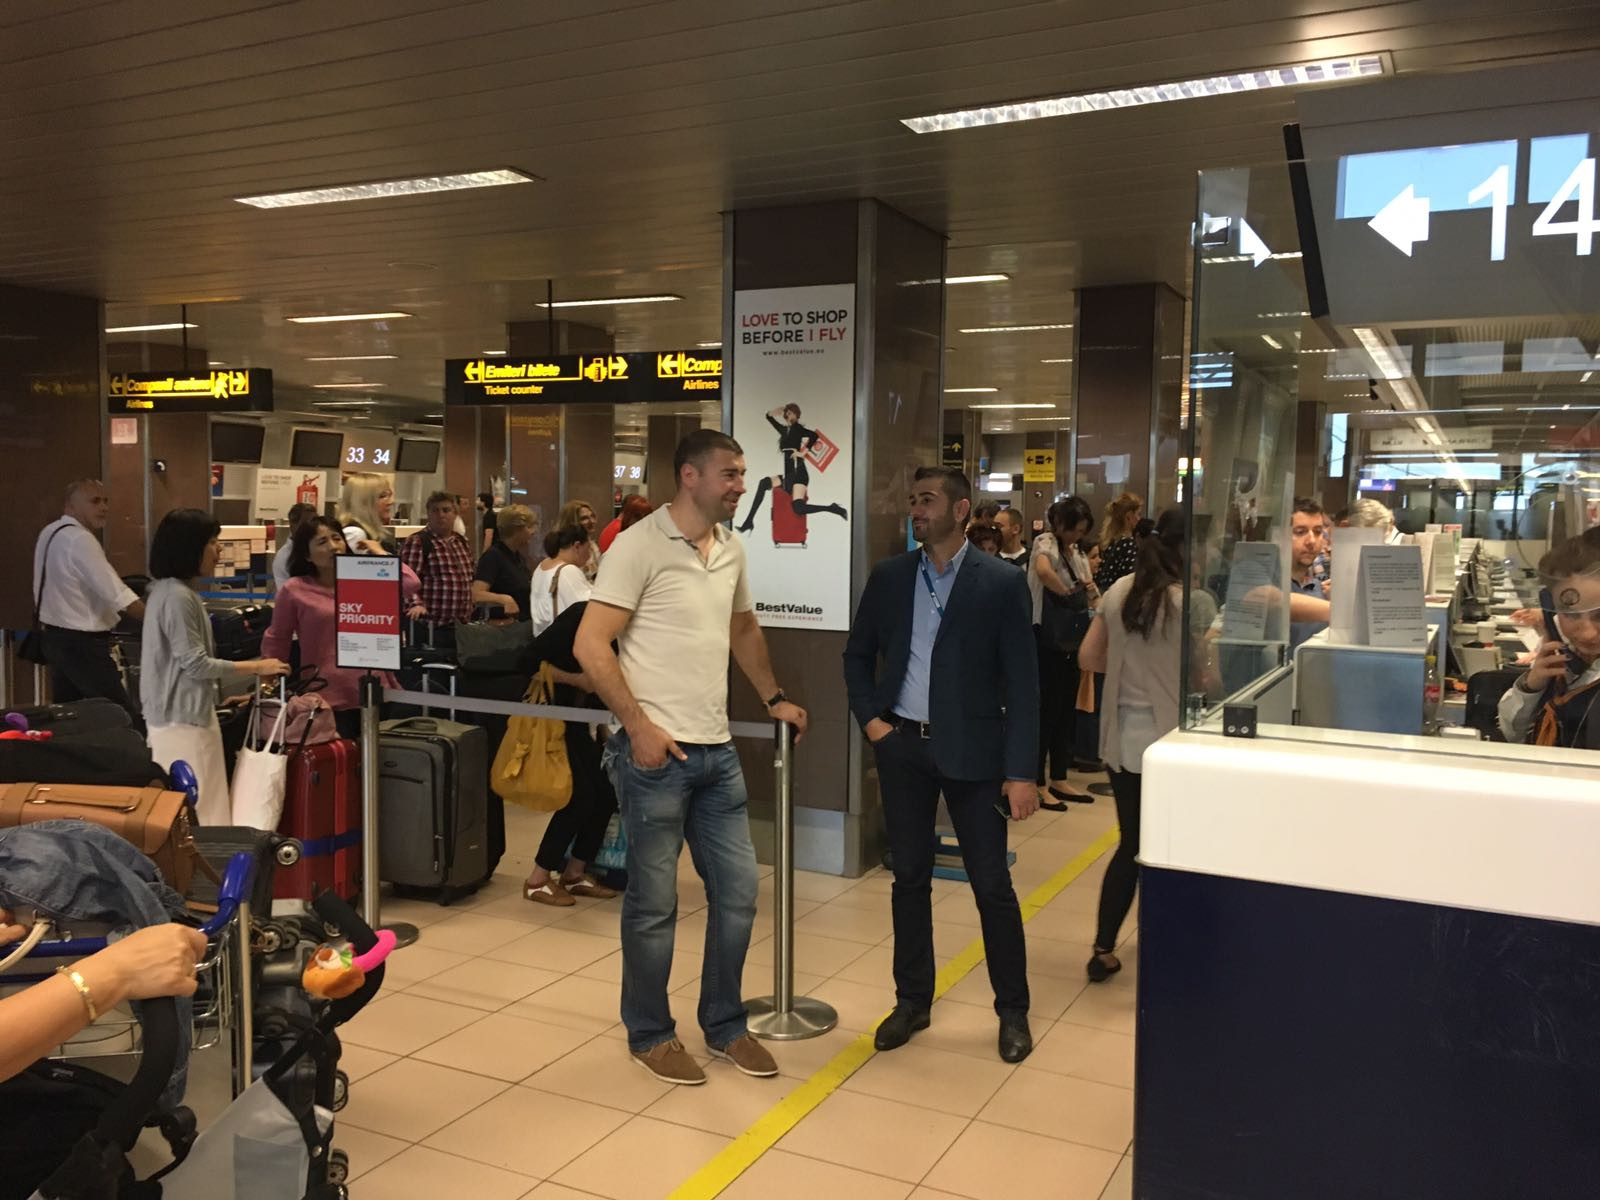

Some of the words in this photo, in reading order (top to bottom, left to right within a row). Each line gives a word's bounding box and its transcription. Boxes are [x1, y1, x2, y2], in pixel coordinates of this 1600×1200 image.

[1468, 157, 1600, 262] 14
[742, 313, 779, 327] LOVE
[782, 311, 803, 326] TO
[806, 309, 848, 325] SHOP
[742, 329, 804, 345] BEFORE
[809, 329, 814, 342] I
[819, 327, 847, 342] FLY
[685, 357, 722, 374] Comp
[484, 385, 510, 395] Ticket
[511, 385, 544, 395] counter
[683, 379, 720, 390] Airlines
[346, 446, 365, 464] 33
[372, 448, 391, 465] 34
[614, 465, 626, 479] 37
[629, 466, 641, 479] 38
[339, 602, 364, 613] SKY
[755, 602, 823, 615] BestValue
[339, 613, 394, 625] PRIORITY
